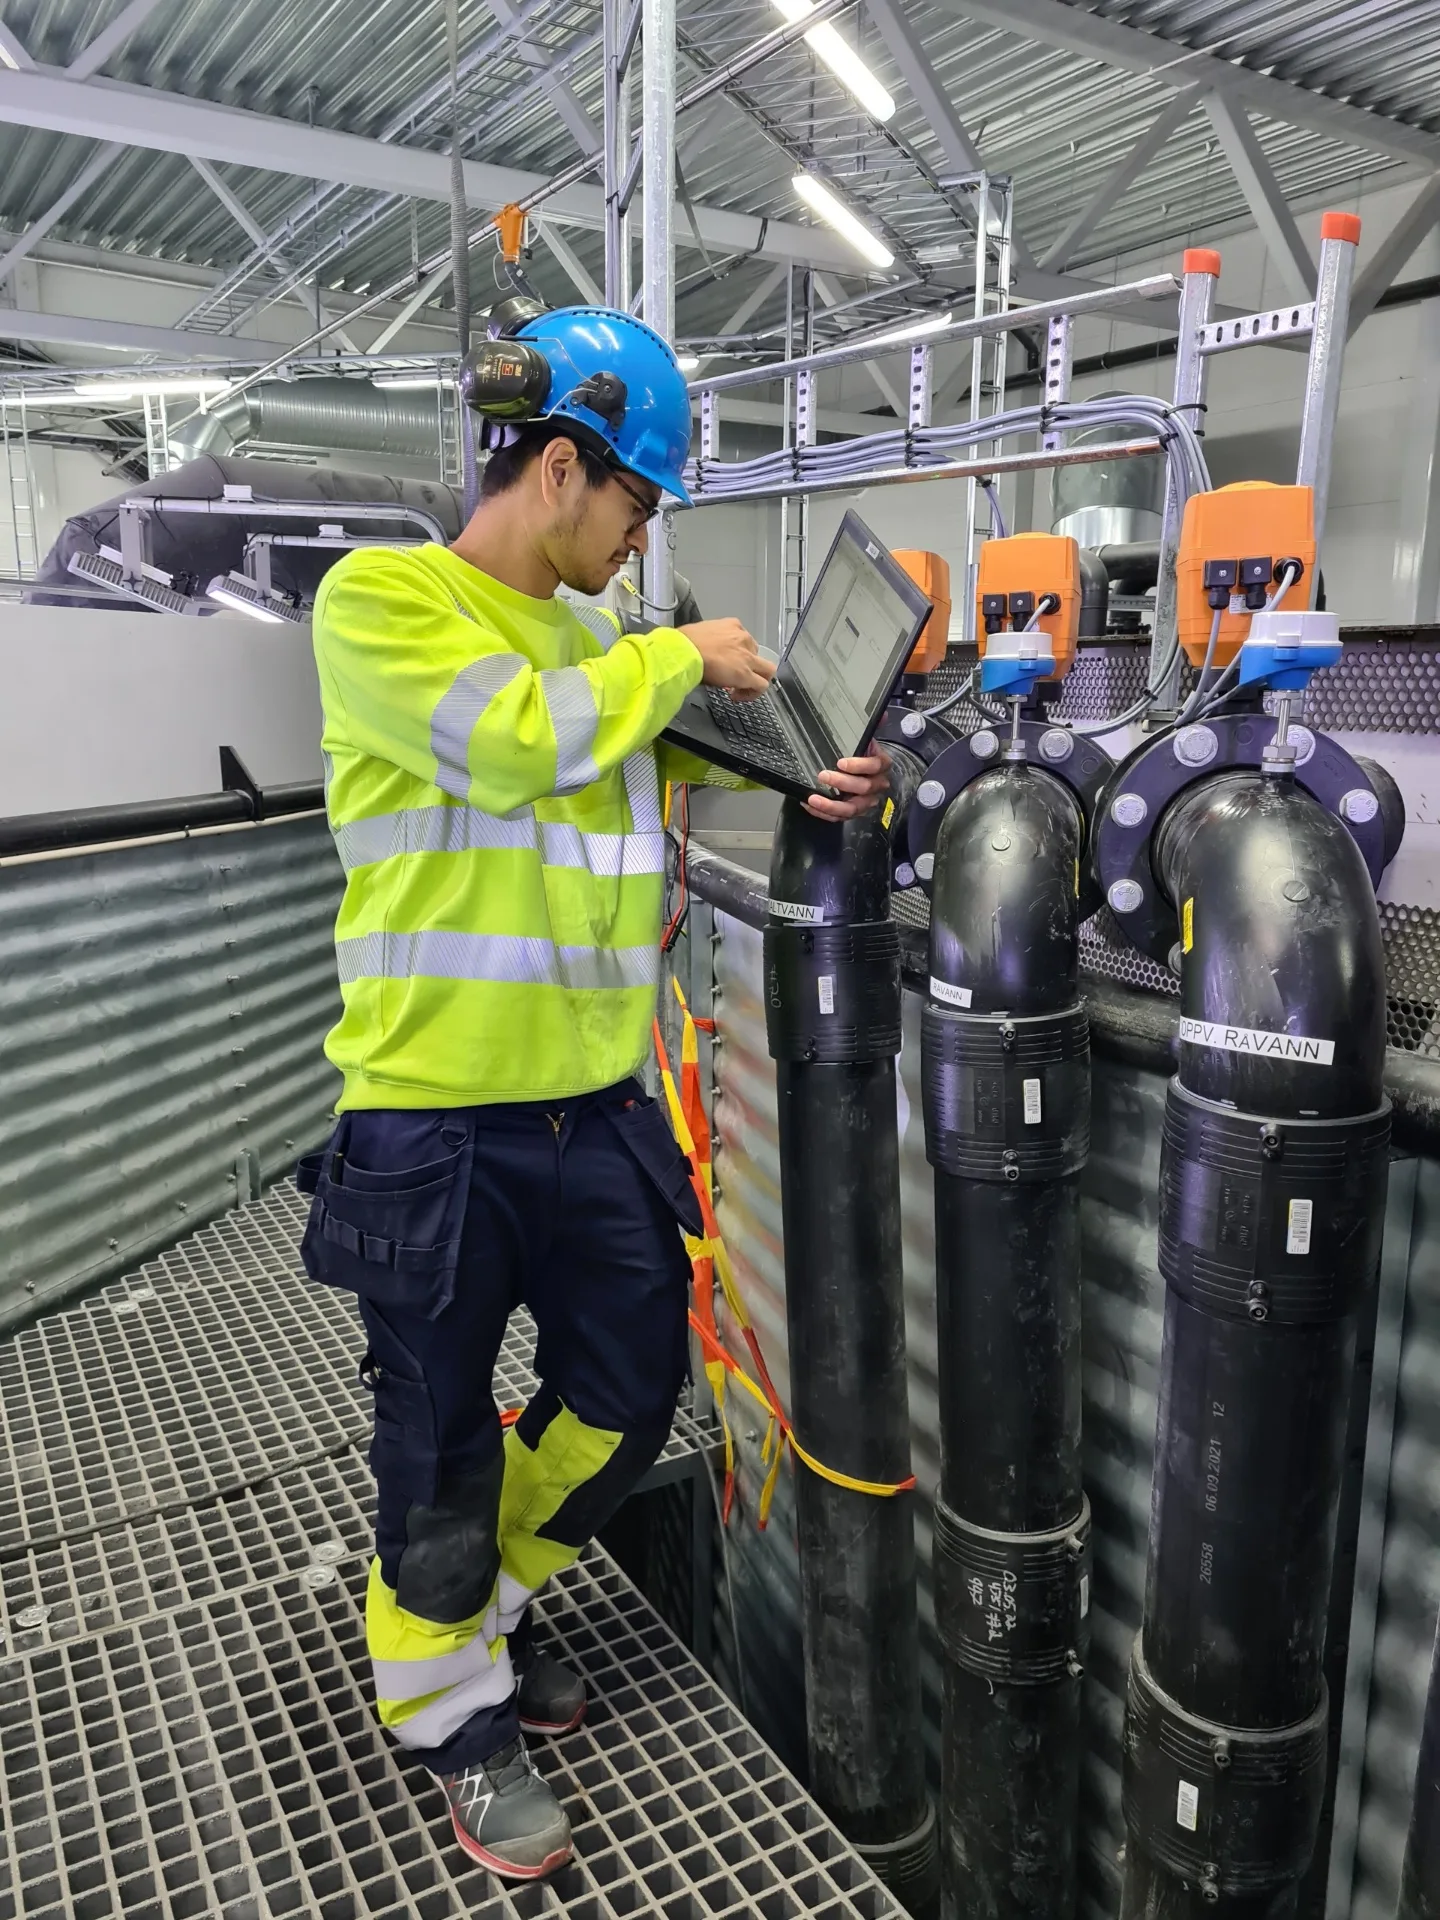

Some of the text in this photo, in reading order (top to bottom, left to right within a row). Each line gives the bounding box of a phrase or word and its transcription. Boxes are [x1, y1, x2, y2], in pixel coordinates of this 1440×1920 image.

[1180, 1020, 1217, 1044] OPPV.
[1199, 1401, 1226, 1585] 26558 06.09.2021 12
